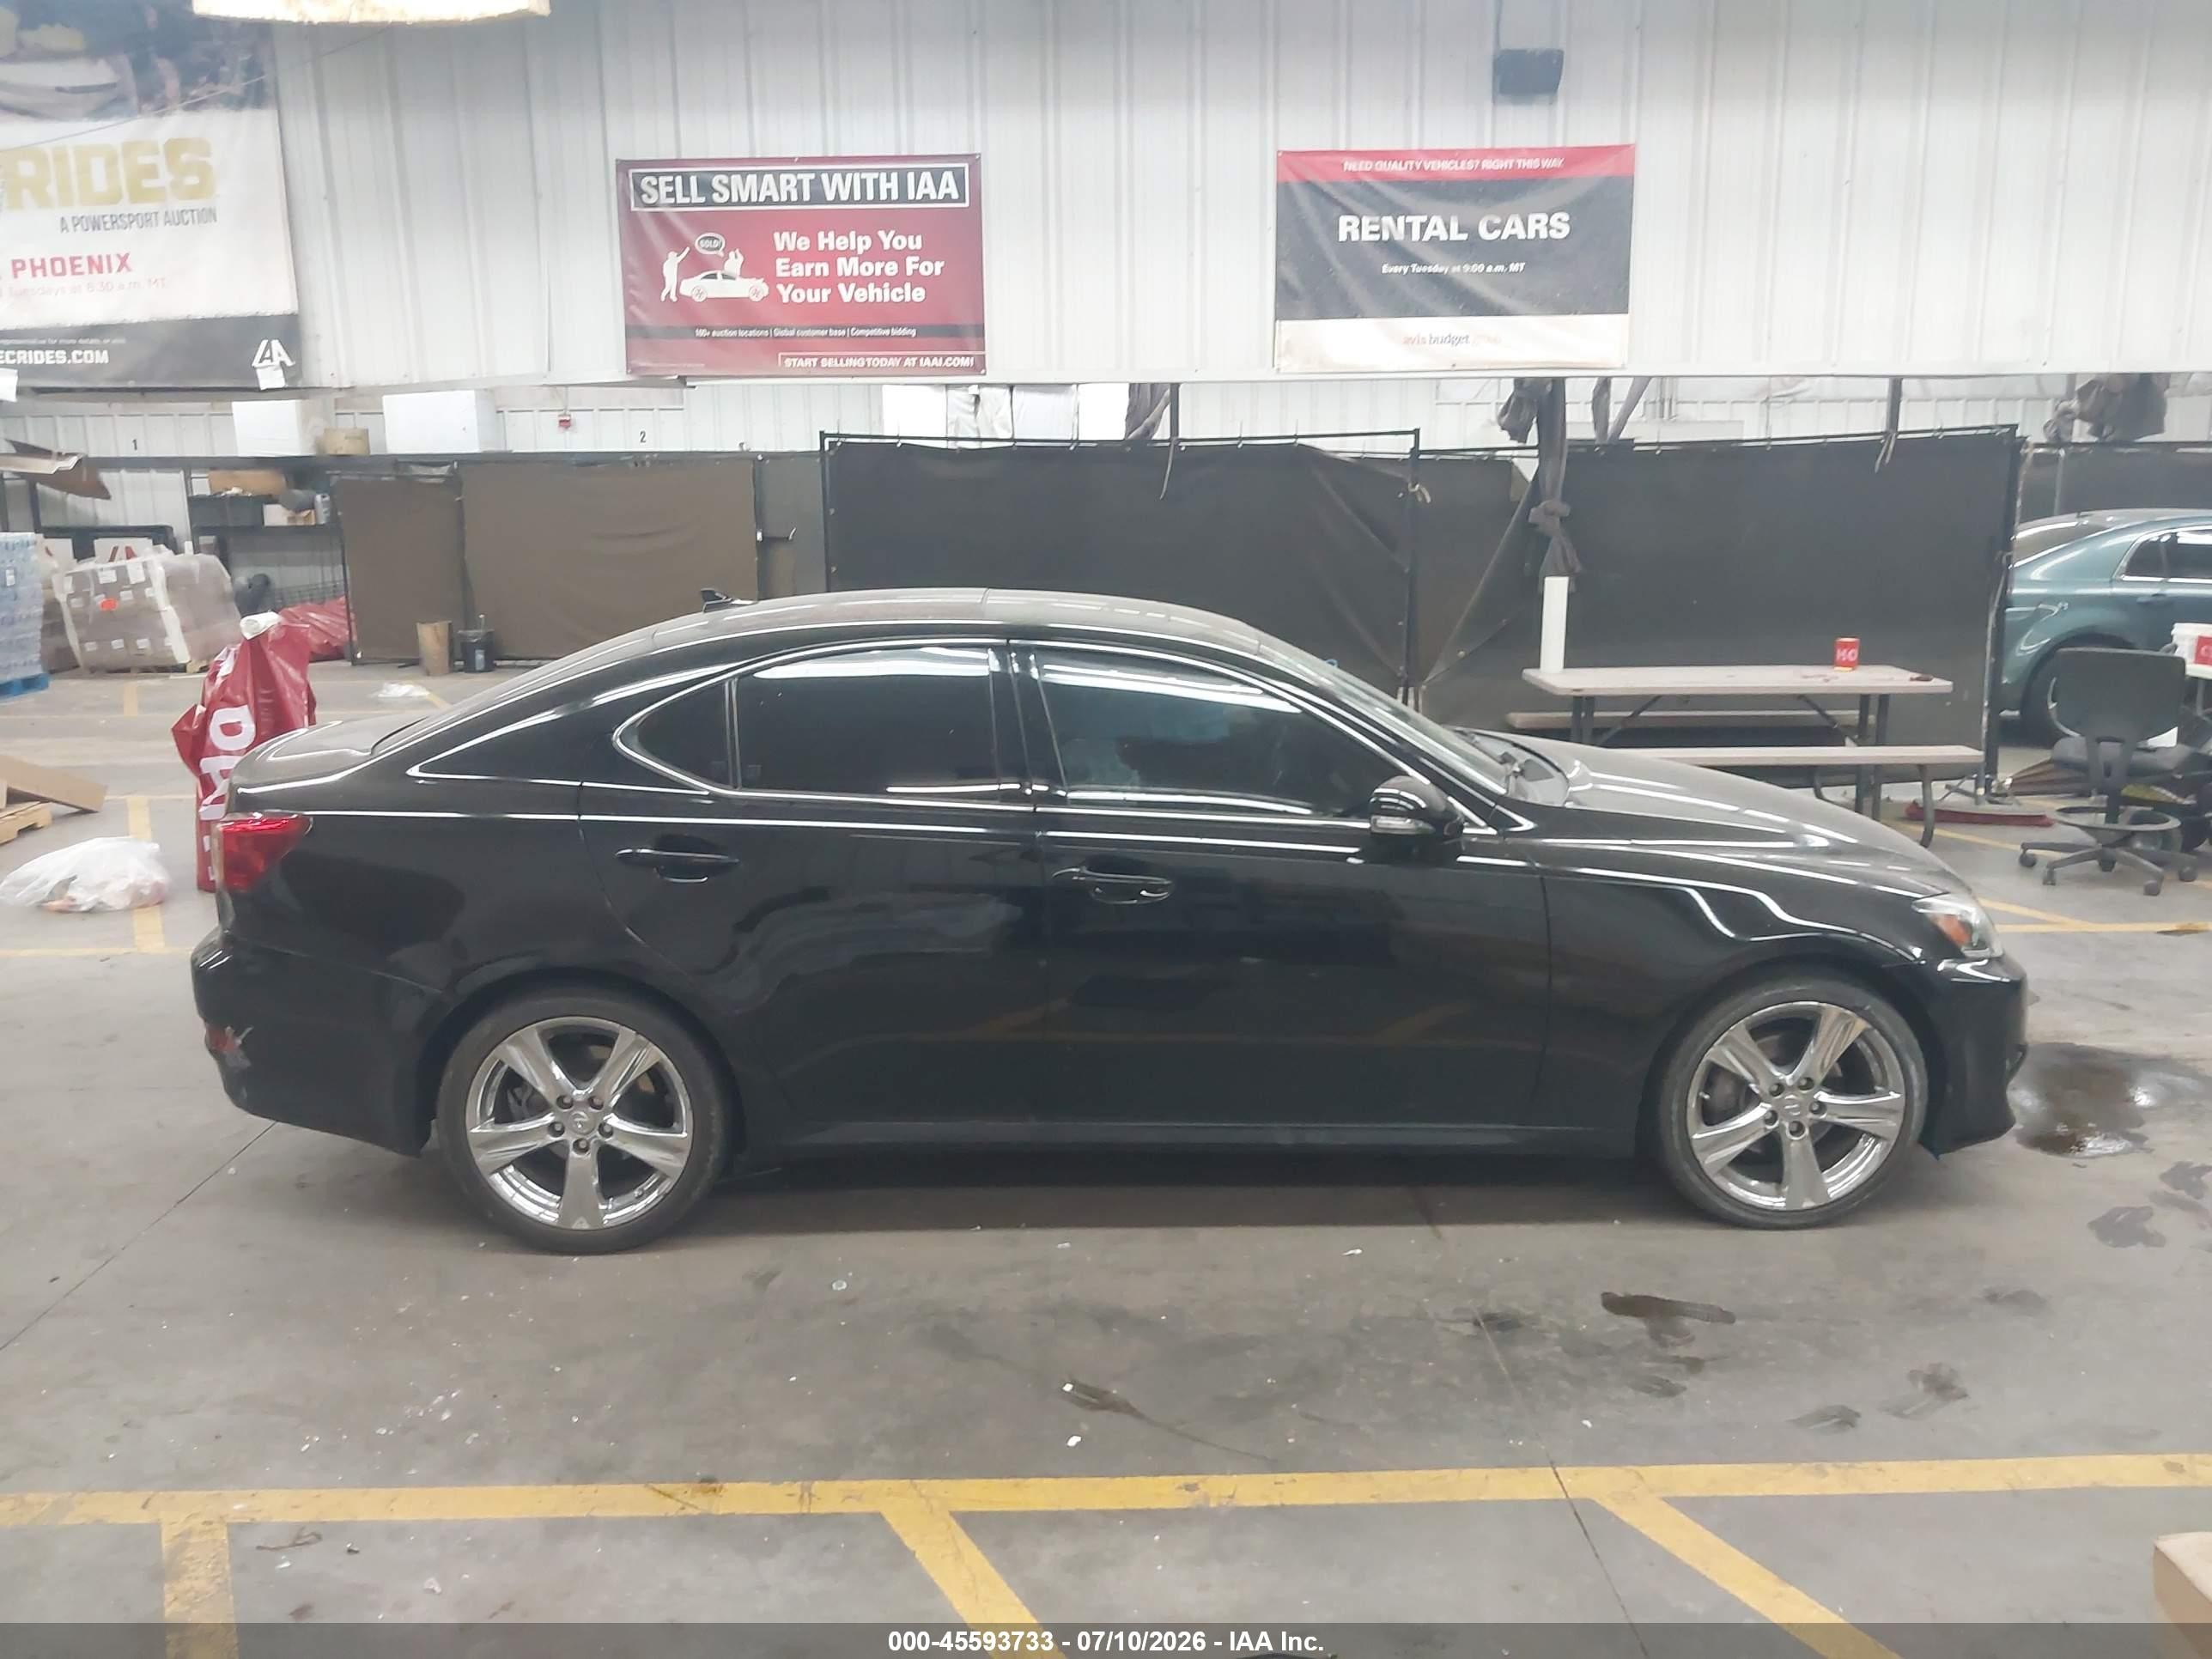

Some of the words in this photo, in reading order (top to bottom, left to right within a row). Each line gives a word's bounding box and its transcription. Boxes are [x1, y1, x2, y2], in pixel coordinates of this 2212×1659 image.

[0, 137, 216, 209] RIDES
[1342, 160, 1373, 172] NEED
[1375, 160, 1422, 172] QUALITY
[1423, 159, 1480, 172] VEHICLES?
[1480, 159, 1515, 170] RIGHT
[1516, 158, 1540, 169] THIS
[641, 174, 706, 204] SELL
[712, 173, 815, 204] SMART
[821, 172, 898, 202] WITH
[908, 171, 959, 201] IAA
[60, 216, 69, 233] A
[73, 211, 159, 233] POWERSPORT
[164, 207, 217, 227] AUCTION
[1339, 215, 1469, 242] RENTAL
[1478, 211, 1571, 240] CARS
[773, 231, 811, 252] We
[817, 230, 872, 255] Help
[877, 229, 922, 251] You
[11, 252, 132, 279] PHOENIX
[775, 258, 830, 277] Earn
[836, 257, 899, 277] More
[905, 256, 945, 276] For
[1381, 263, 1410, 275] Every
[1411, 263, 1449, 275] Tuesday
[1509, 262, 1526, 273] MT
[776, 283, 831, 303] Your
[837, 282, 927, 303] Vehicle
[712, 328, 738, 337] auction
[738, 328, 769, 337] locations
[774, 327, 795, 337] Global
[796, 328, 828, 337] customer
[829, 327, 846, 337] base
[850, 326, 890, 337] Competitive
[890, 327, 916, 337] bidding
[1429, 332, 1470, 348] budget
[784, 357, 818, 368] START
[903, 356, 917, 367] AT
[132, 439, 137, 451] 1
[640, 430, 647, 443] 2
